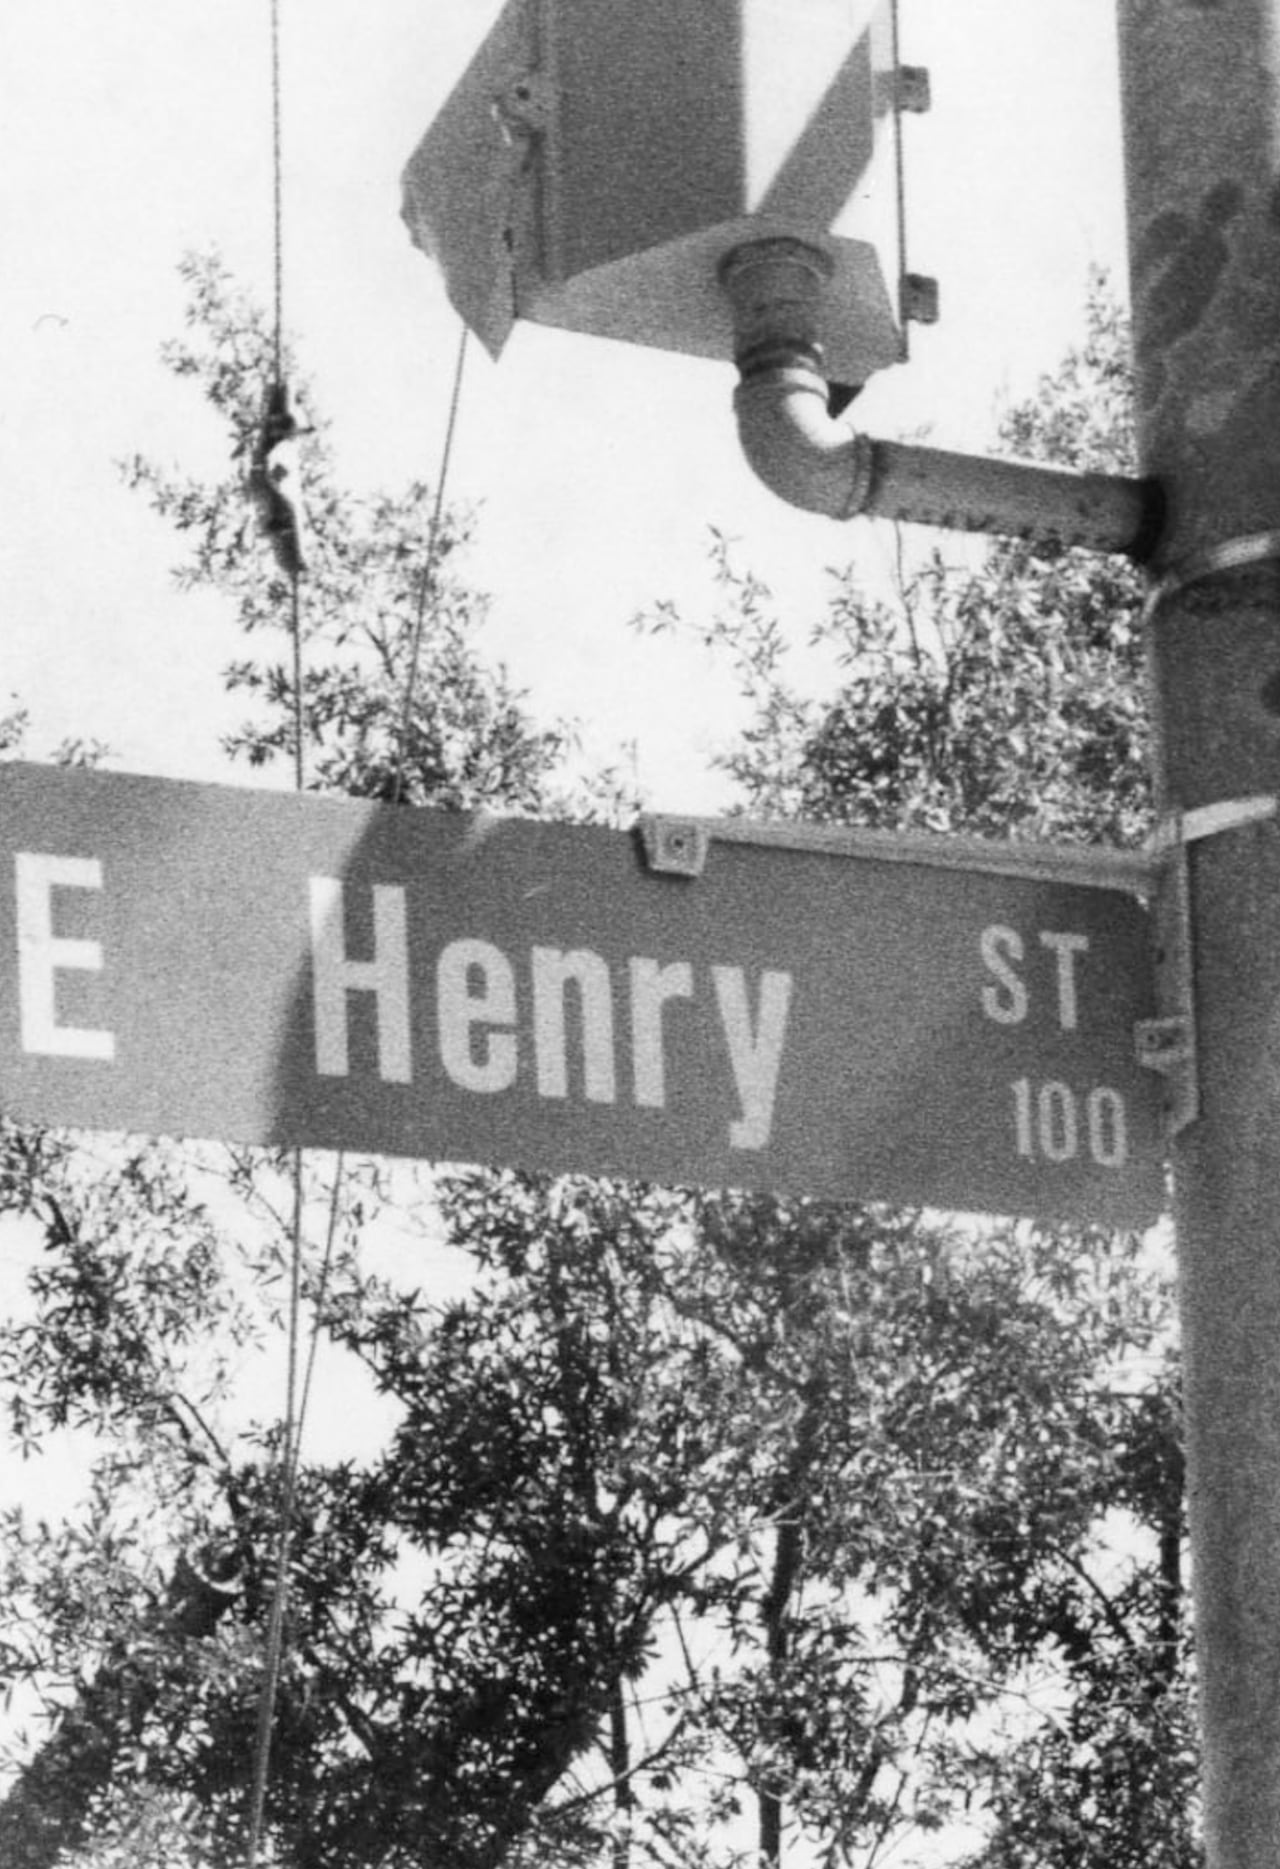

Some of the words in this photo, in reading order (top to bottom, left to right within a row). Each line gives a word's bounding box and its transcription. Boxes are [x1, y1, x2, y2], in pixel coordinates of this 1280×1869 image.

[15, 853, 116, 1061] E
[309, 876, 792, 1150] Henry
[980, 925, 1091, 1029] ST
[1012, 1077, 1128, 1167] 100
